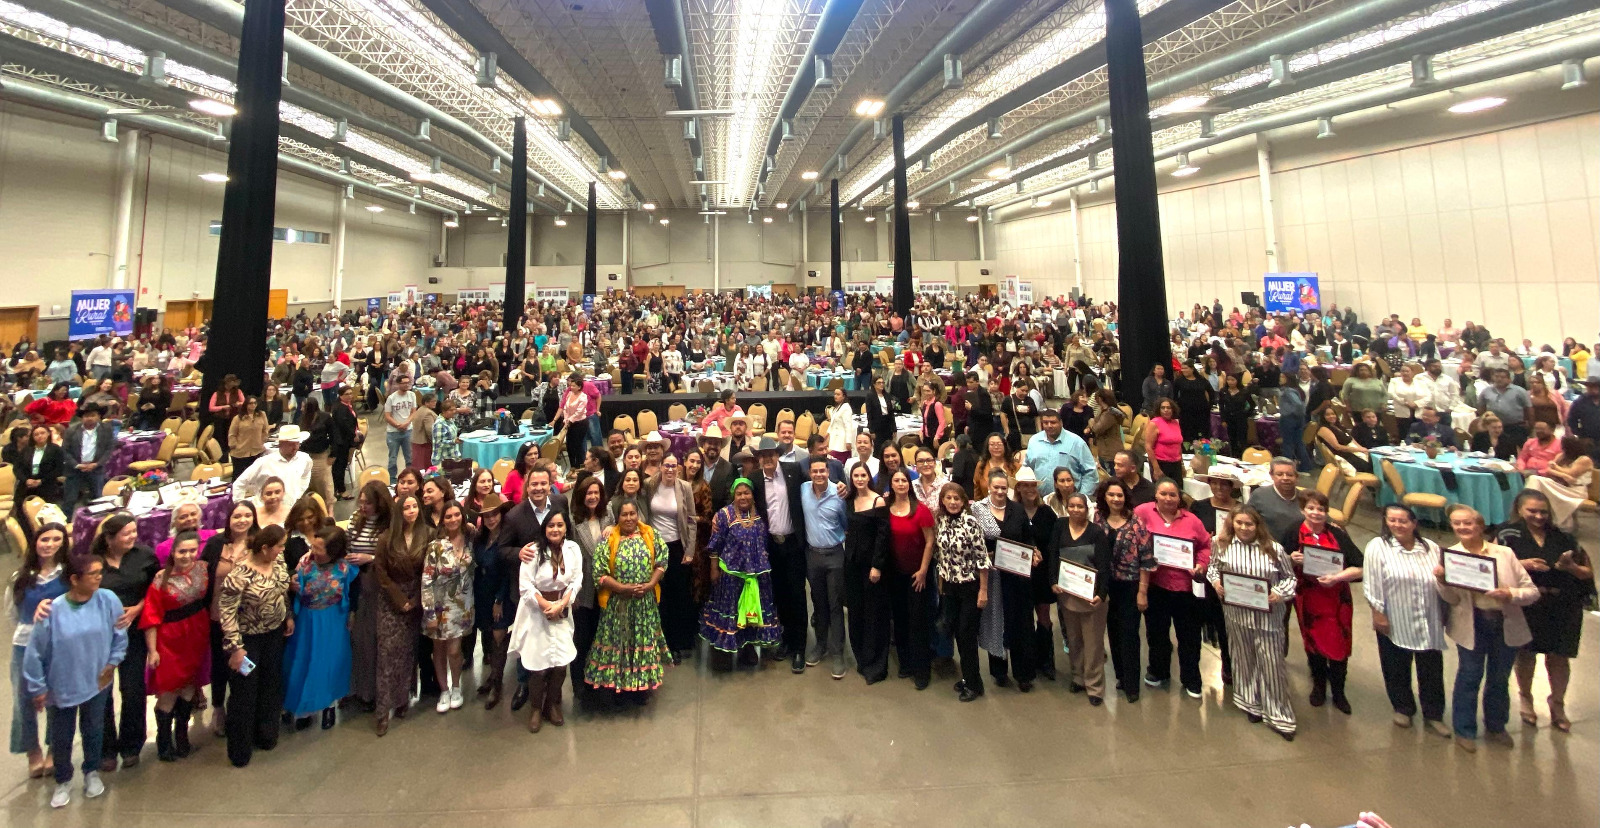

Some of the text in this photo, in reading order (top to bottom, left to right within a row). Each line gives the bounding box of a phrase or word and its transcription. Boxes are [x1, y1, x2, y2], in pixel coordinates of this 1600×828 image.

[1268, 281, 1295, 292] MUJER
[1269, 290, 1294, 303] Rural
[76, 299, 110, 311] MUJER
[75, 309, 108, 324] Rural
